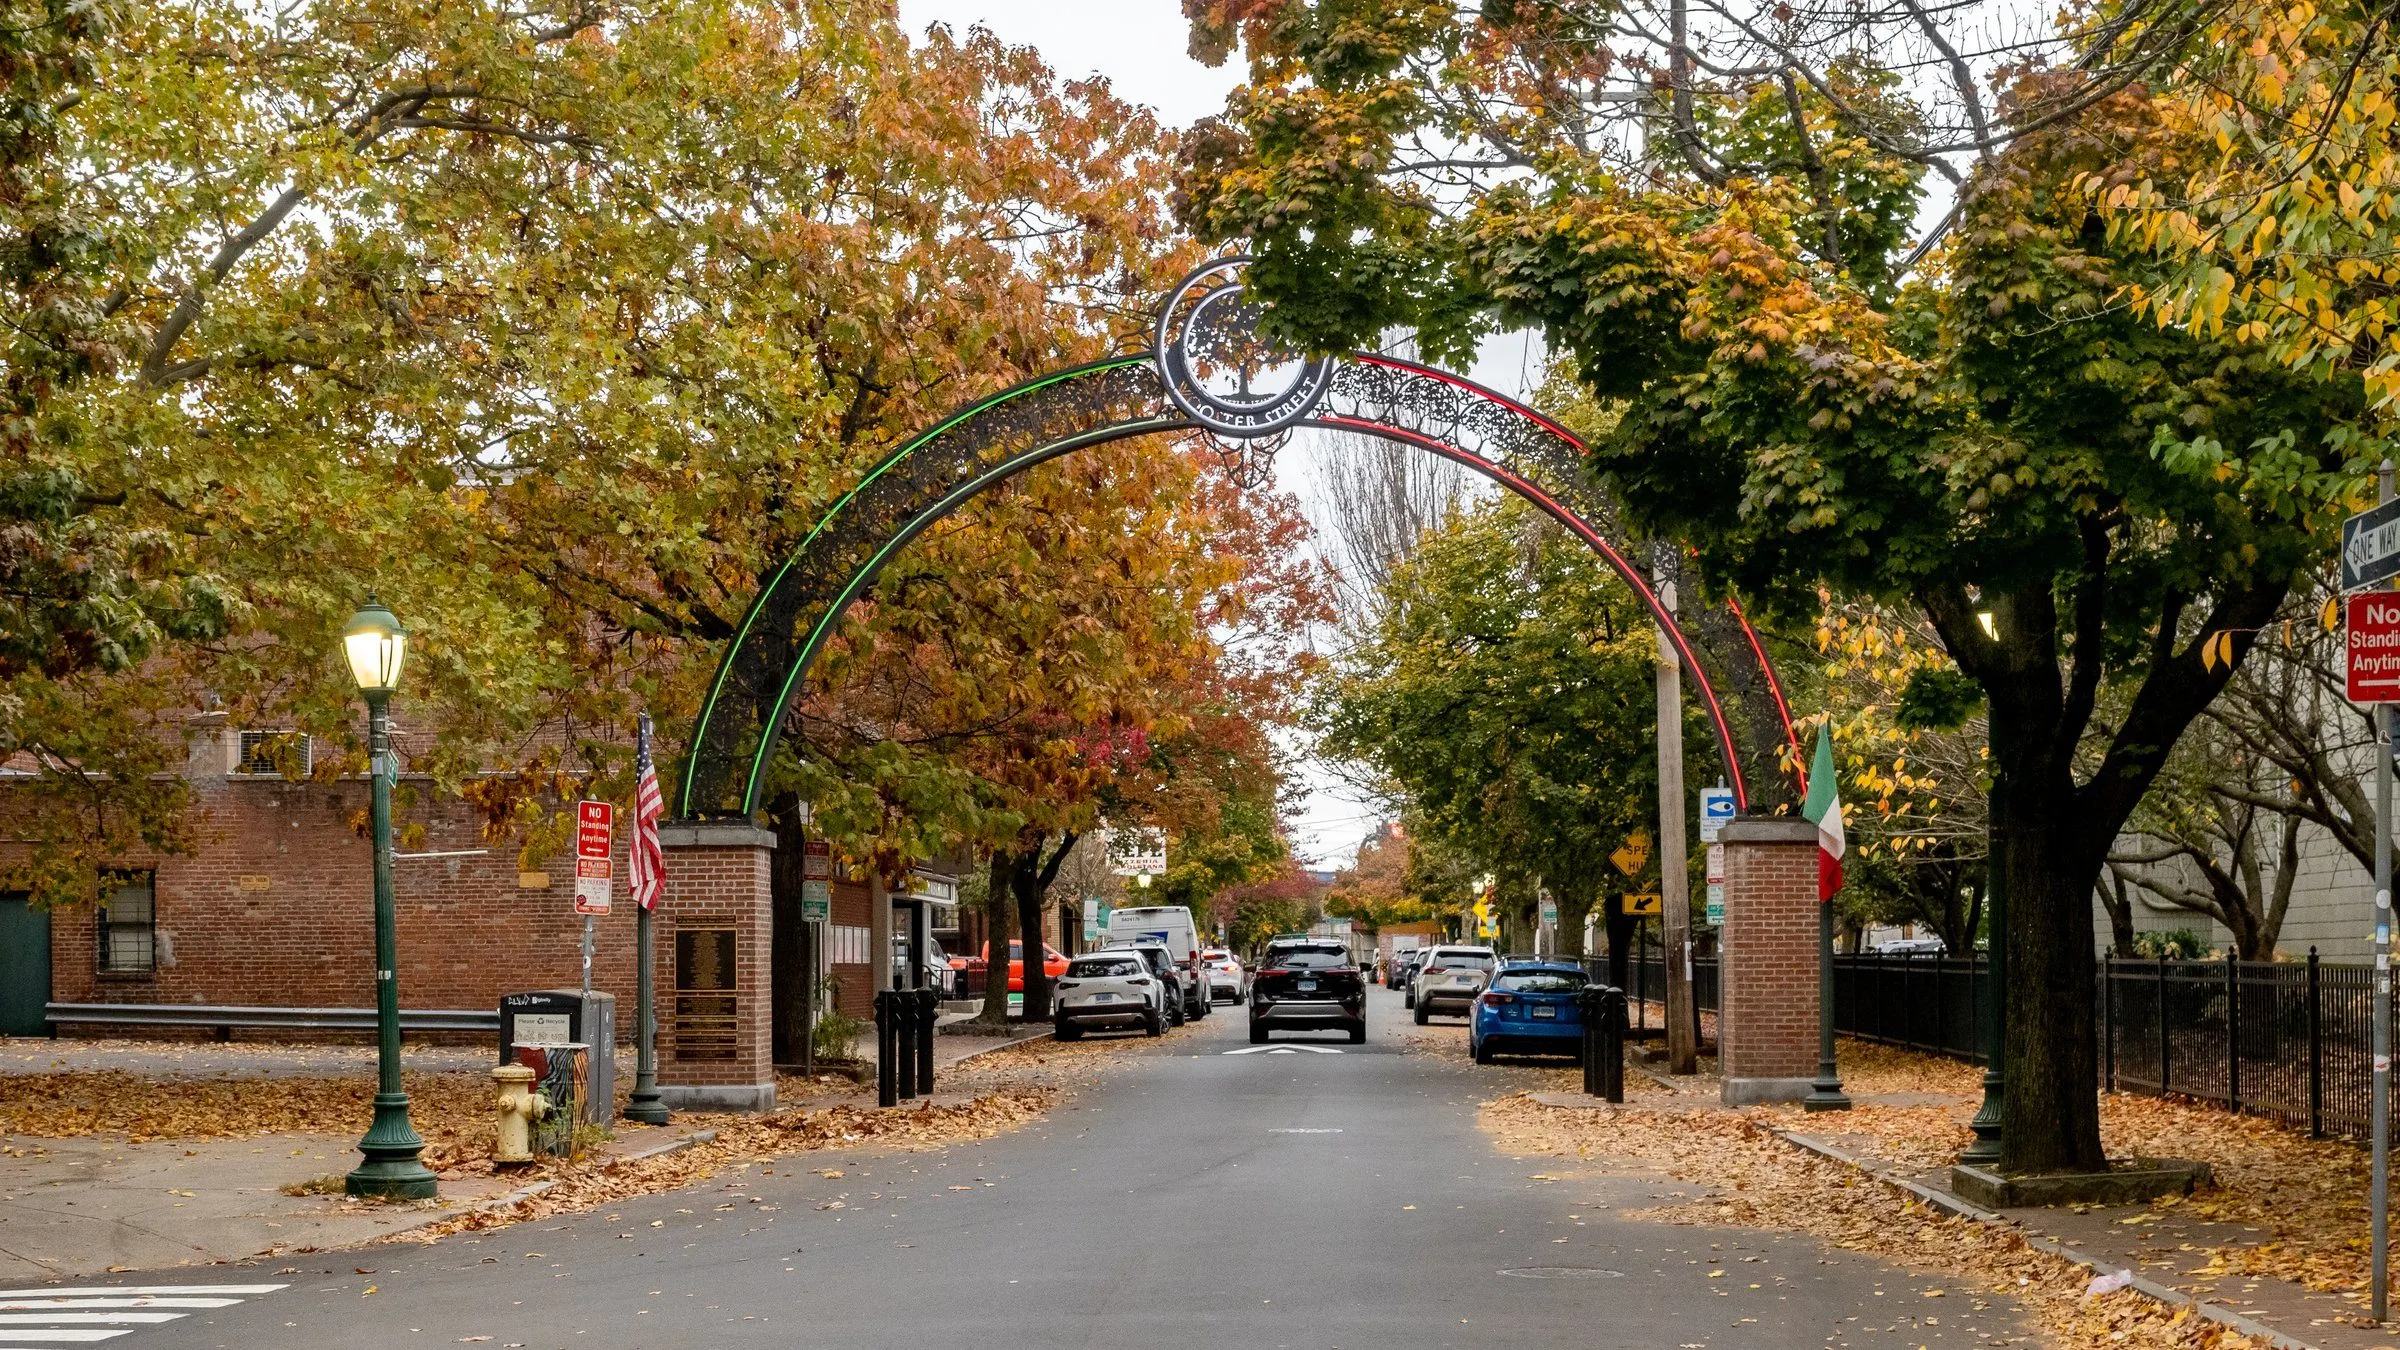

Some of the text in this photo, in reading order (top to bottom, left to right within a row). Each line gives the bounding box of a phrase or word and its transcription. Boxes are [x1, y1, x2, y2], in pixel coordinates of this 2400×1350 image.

[1265, 377, 1317, 423] STREET
[2353, 522, 2397, 565] ONE WAY
[2366, 604, 2400, 625] No
[2350, 629, 2400, 649] Standi
[2353, 653, 2400, 675] Anytim
[589, 807, 601, 819] NO
[580, 820, 609, 833] Standing
[581, 833, 608, 844] Anytime
[1626, 845, 1648, 856] SPE
